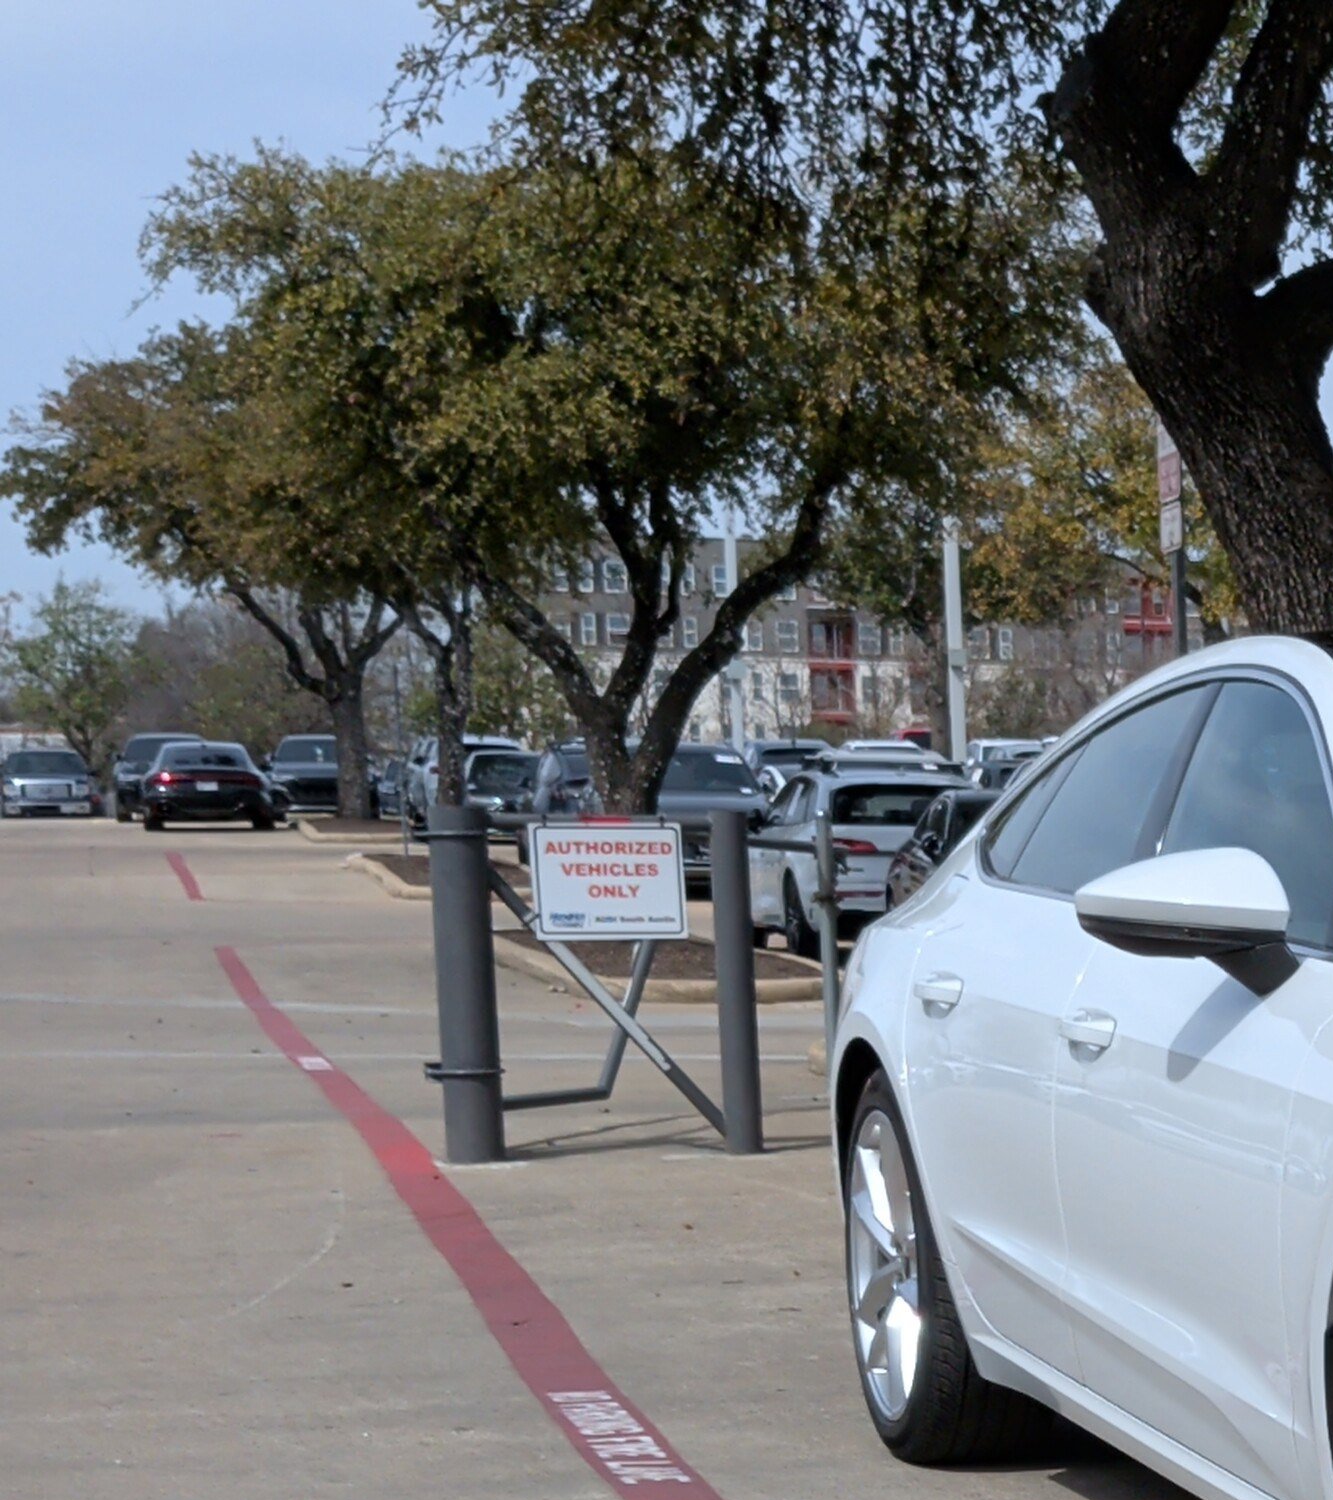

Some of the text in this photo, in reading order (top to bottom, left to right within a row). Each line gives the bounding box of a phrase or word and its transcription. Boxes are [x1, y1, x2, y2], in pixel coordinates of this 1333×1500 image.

[545, 841, 672, 855] AUTHORIZED
[561, 863, 659, 877] VEHICLES
[588, 885, 640, 898] ONLY
